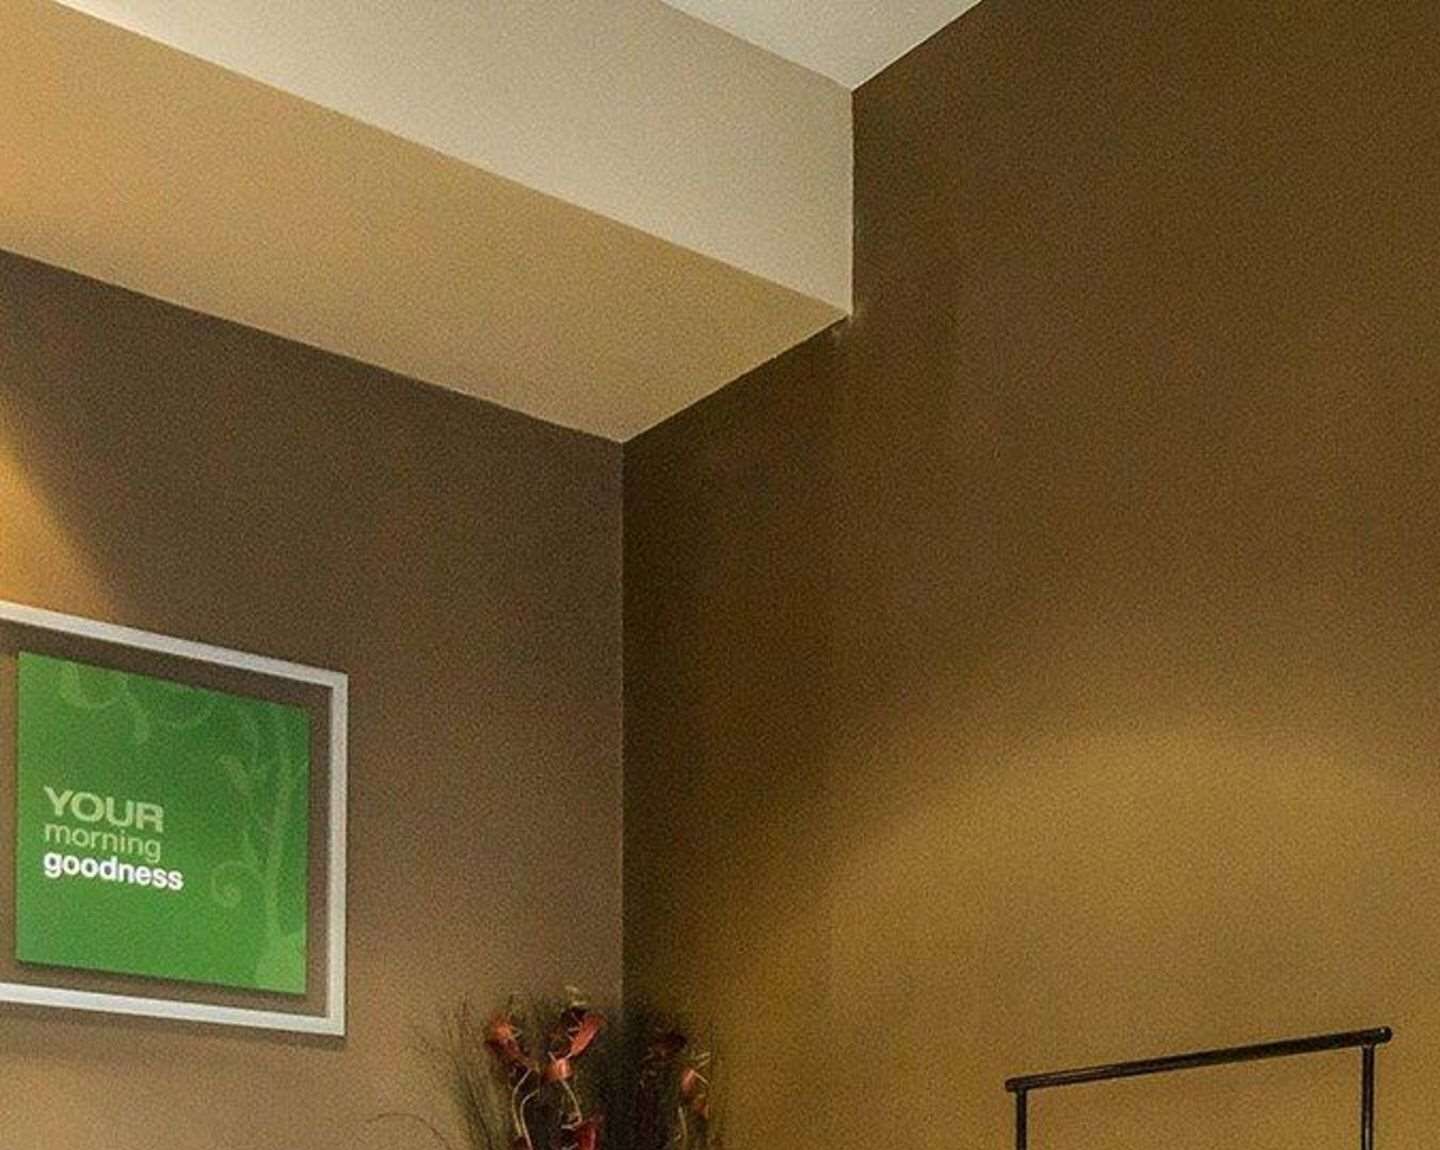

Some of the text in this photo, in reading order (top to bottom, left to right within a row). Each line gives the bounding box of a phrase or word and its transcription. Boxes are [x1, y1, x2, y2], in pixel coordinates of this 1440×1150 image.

[43, 785, 164, 833] YOUR
[44, 823, 162, 865] morning
[43, 851, 185, 891] goodness
